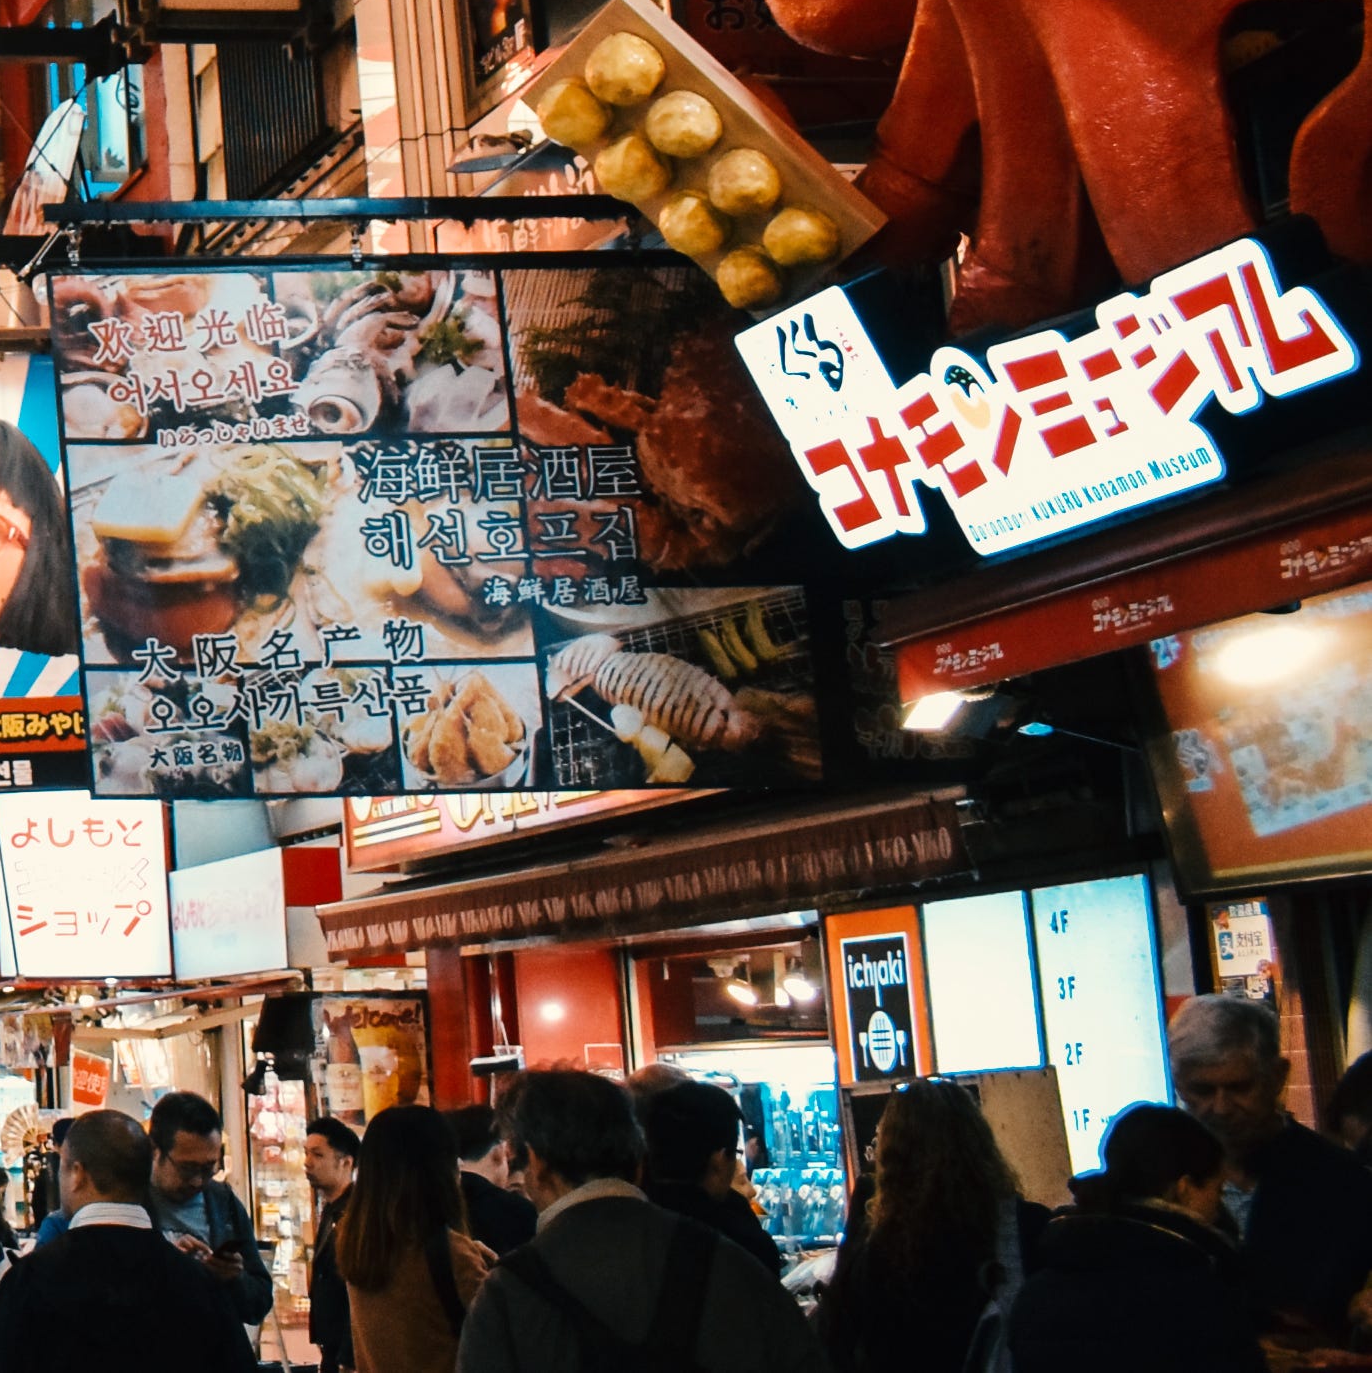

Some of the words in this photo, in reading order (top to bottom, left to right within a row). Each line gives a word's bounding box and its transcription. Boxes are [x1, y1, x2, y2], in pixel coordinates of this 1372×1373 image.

[88, 303, 289, 364] 欢迎光临
[108, 359, 302, 413] 어서오세요
[158, 415, 309, 448] いらっしゃいませ
[359, 507, 639, 569] 해선호프집
[484, 577, 646, 606] 海鮮居酒屋
[133, 617, 425, 683] 大阪名产物
[145, 674, 432, 735] 오오사까특산품
[150, 742, 245, 767] 大阪名物
[11, 817, 143, 848] よしもと
[16, 900, 152, 937] ショップ
[1050, 910, 1069, 934] 4F
[1058, 976, 1076, 1000] 3F
[1065, 1042, 1084, 1066] 2F
[1073, 1109, 1090, 1131] 1F
